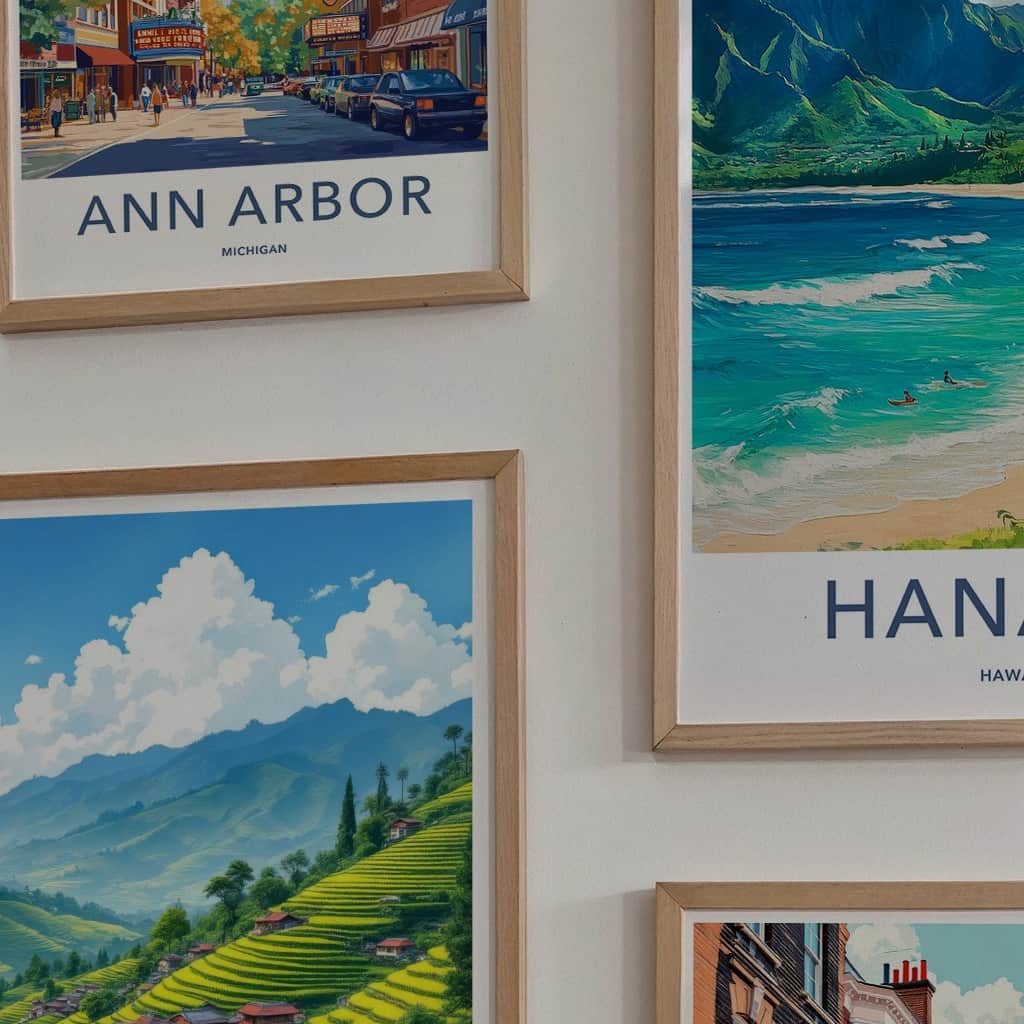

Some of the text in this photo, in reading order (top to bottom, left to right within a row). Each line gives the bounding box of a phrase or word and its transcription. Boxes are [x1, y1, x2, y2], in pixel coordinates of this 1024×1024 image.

[76, 175, 432, 236] ANN ARBOR
[221, 243, 288, 257] MICHIGAN
[826, 577, 1024, 640] HAN
[980, 668, 1024, 682] HAW
